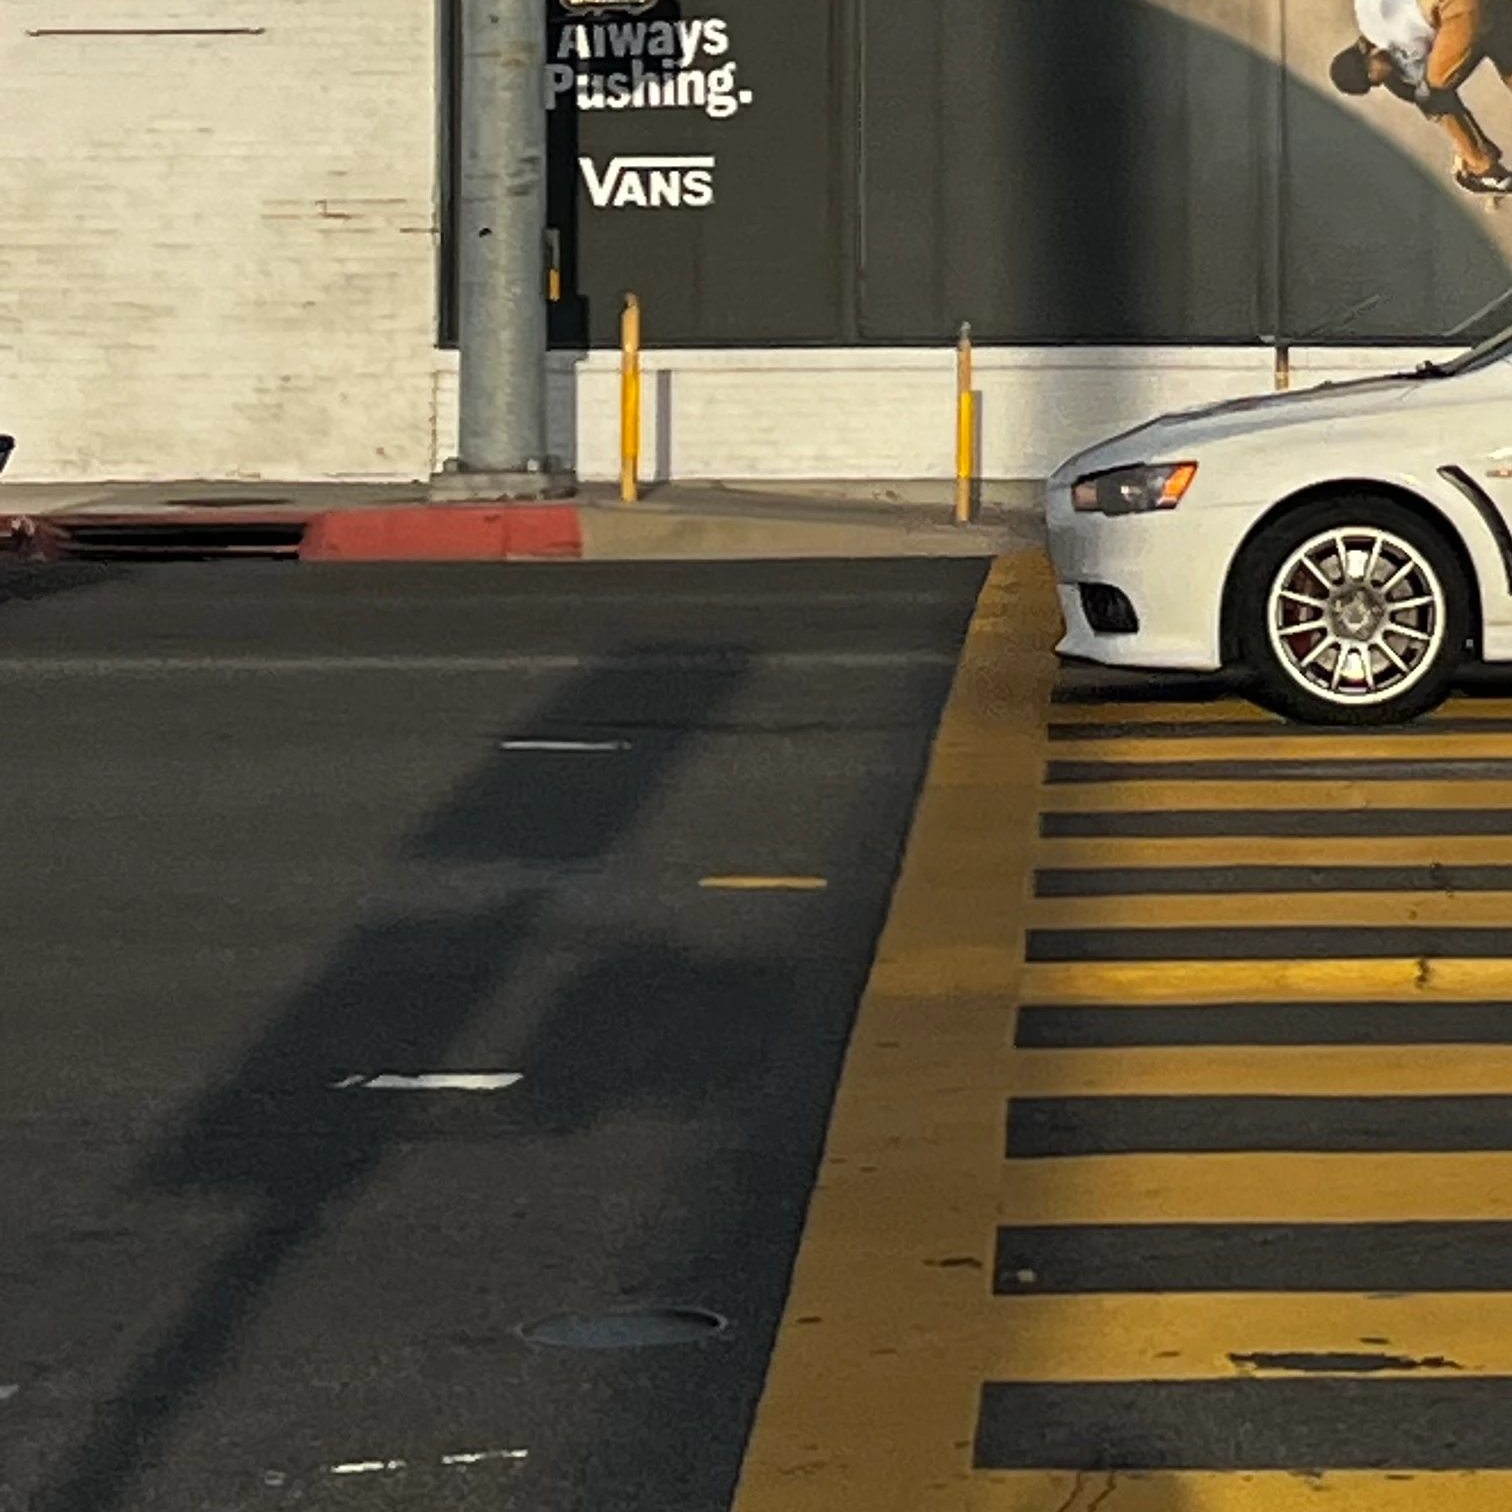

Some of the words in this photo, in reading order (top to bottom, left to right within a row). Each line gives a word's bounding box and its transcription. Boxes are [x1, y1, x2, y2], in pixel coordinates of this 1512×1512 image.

[556, 18, 730, 68] Always
[544, 58, 753, 118] Pushing.
[577, 156, 716, 207] VANS
